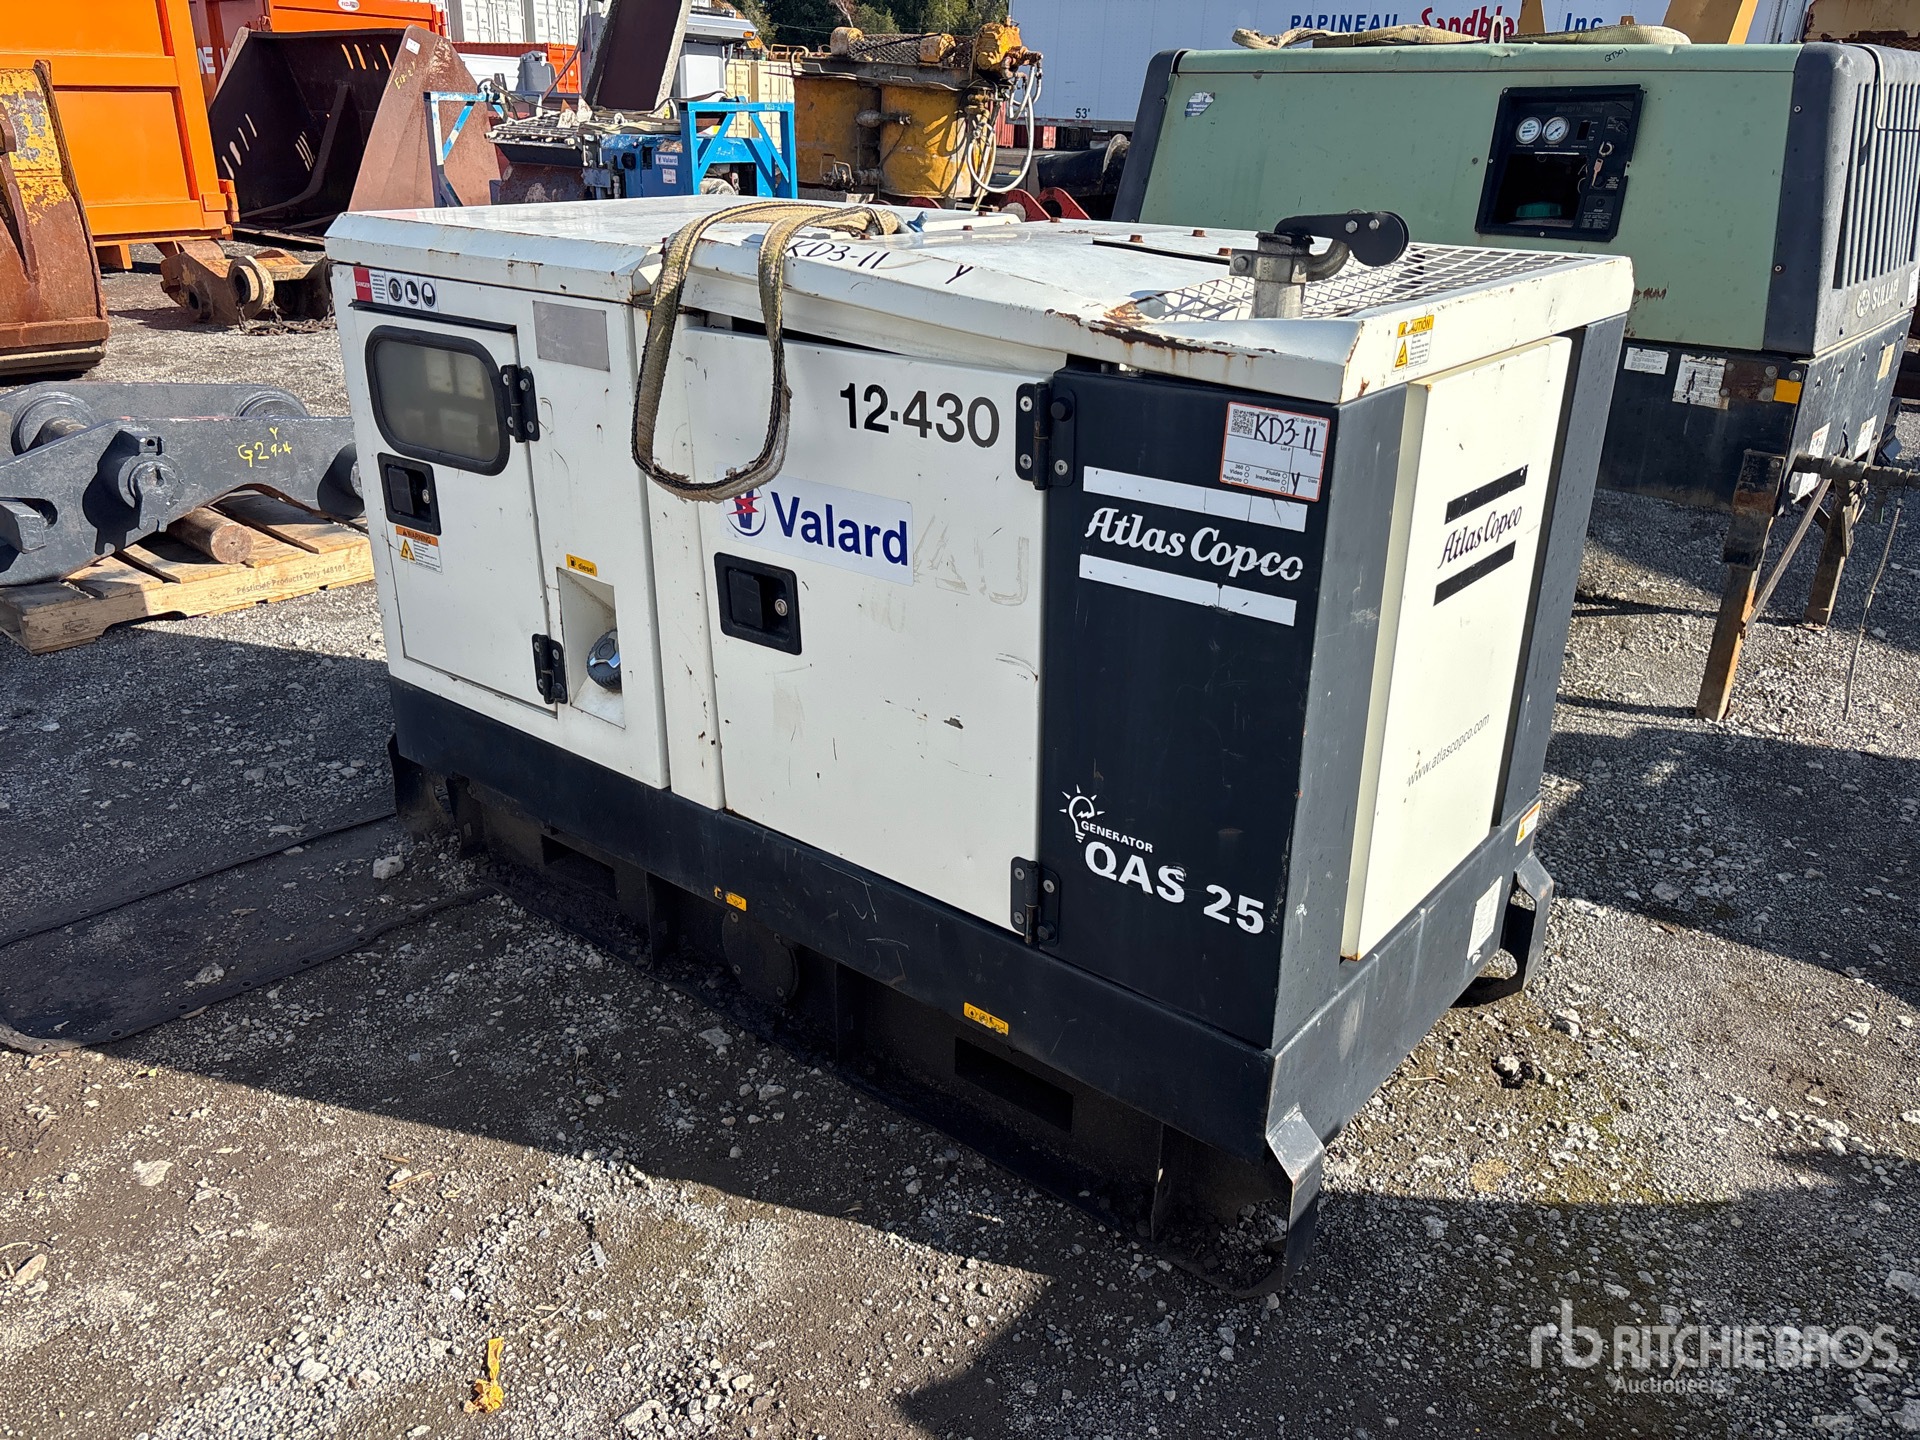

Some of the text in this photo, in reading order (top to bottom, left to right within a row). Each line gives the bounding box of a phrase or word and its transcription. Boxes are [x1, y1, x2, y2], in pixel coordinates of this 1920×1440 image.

[1290, 13, 1398, 33] PAPINEAU
[785, 239, 890, 270] KD3-11
[1253, 413, 1317, 452] KD3-11
[1255, 474, 1280, 484] Inspection
[1266, 469, 1281, 477] Fluids
[408, 530, 431, 544] WARNING
[770, 491, 909, 567] Valard
[1084, 506, 1304, 582] Atlas Copco
[1437, 505, 1523, 570] Atlas Copco
[271, 573, 303, 586] Products
[303, 570, 320, 580] Only
[578, 562, 595, 574] diesel
[1406, 713, 1490, 788] www.atlascopco.com
[1080, 820, 1153, 854] GENERATOR
[1085, 841, 1264, 934] QAS 25
